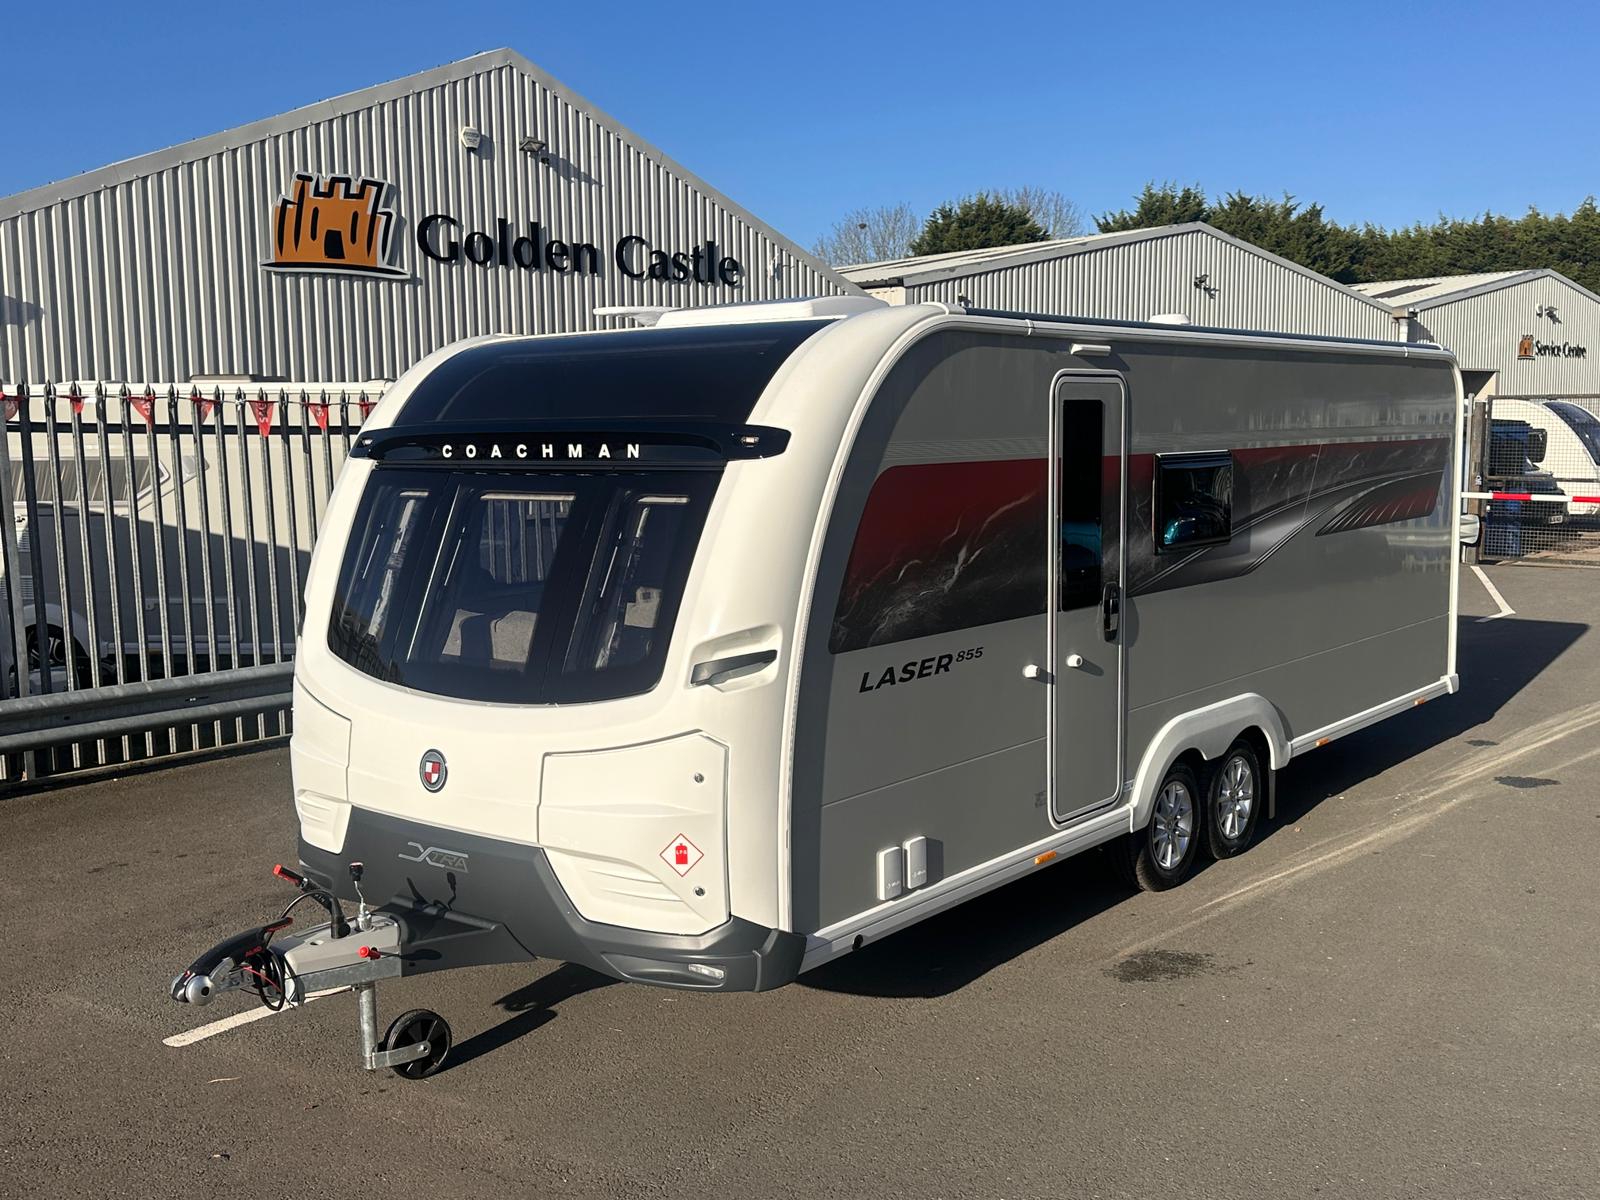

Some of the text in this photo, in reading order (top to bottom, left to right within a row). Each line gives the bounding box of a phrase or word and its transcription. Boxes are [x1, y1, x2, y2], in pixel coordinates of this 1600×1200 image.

[417, 213, 739, 286] Golden Castle
[1535, 340, 1587, 359] Service Centre
[442, 444, 640, 458] COACHMAN
[859, 646, 984, 693] LASER 855
